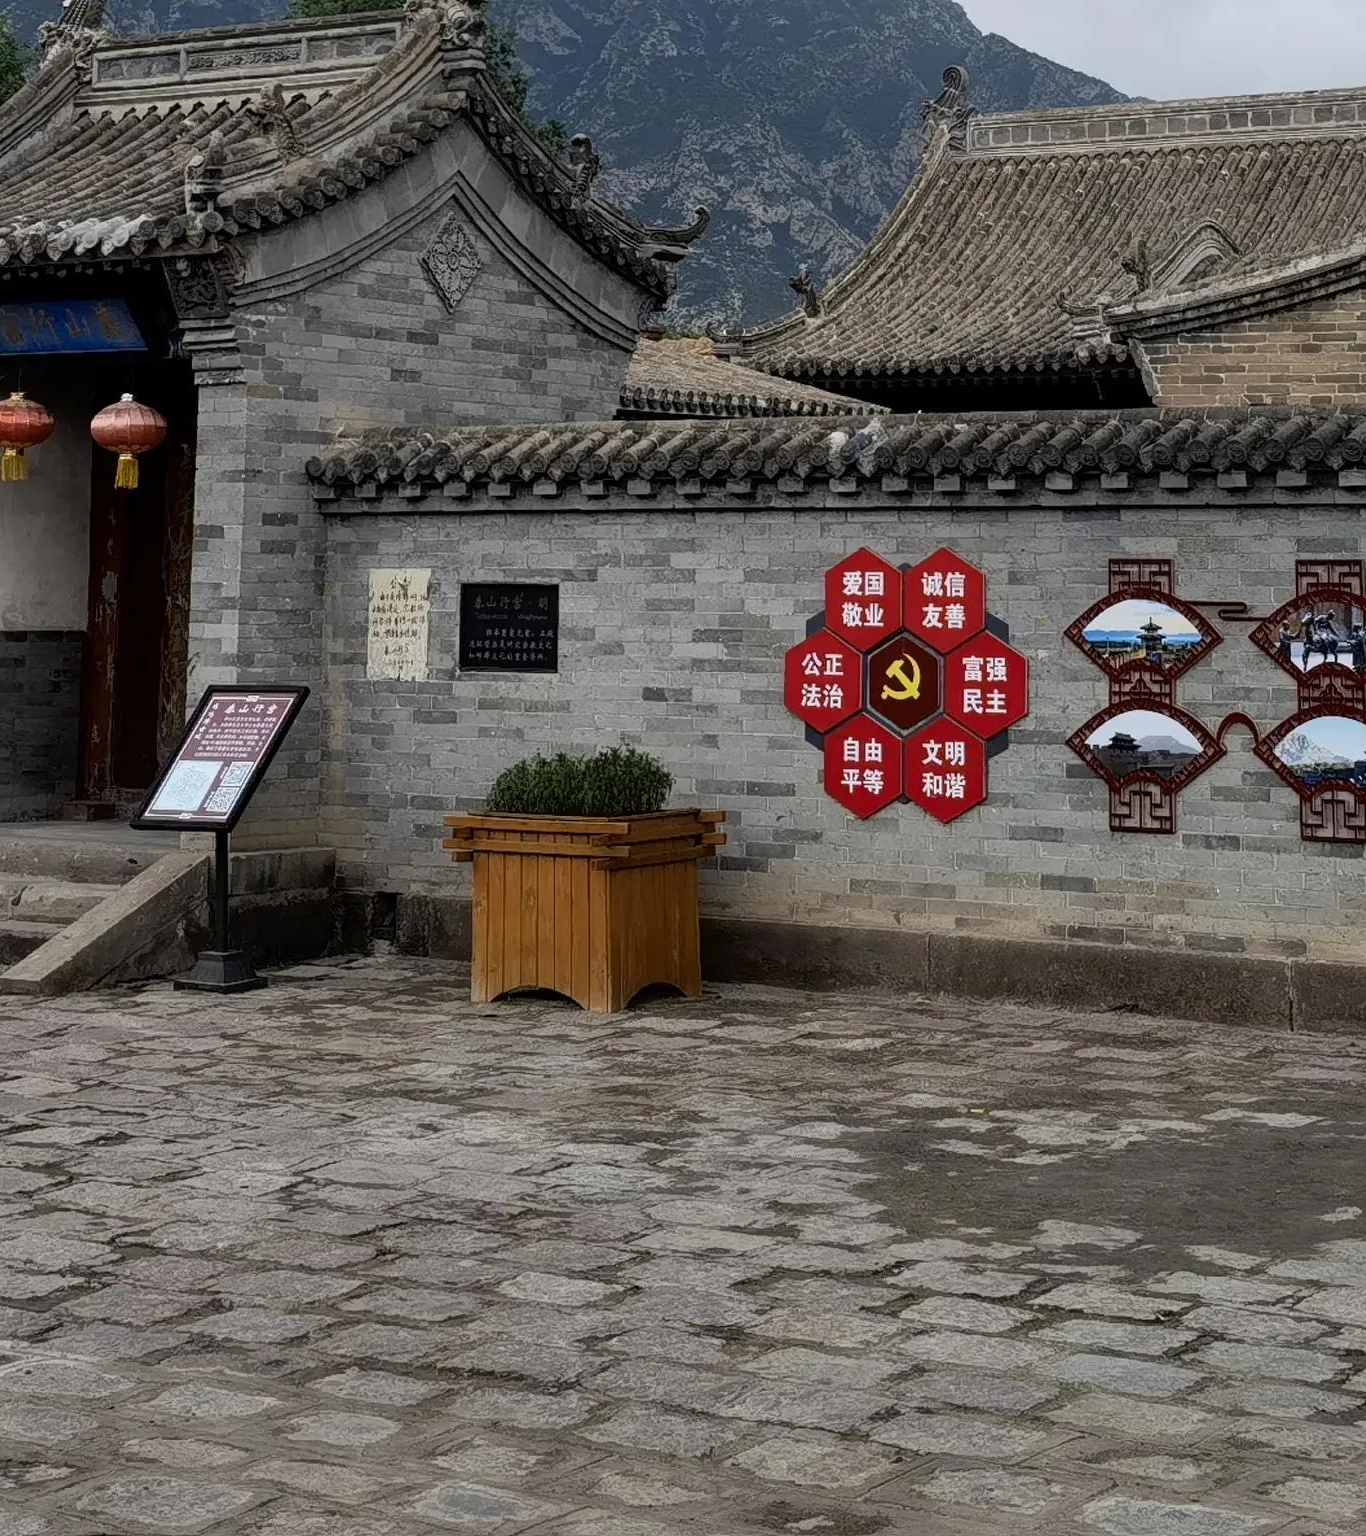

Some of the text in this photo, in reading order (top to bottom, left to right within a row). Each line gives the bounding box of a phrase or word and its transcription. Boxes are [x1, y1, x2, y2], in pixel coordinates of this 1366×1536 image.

[842, 571, 884, 596] 爱国
[922, 571, 966, 597] 诚信
[841, 602, 884, 627] 敬业
[922, 602, 966, 628] 友善
[801, 652, 844, 676] 公正
[963, 655, 1008, 682] 富强
[801, 683, 844, 709] 法治
[963, 689, 1007, 714] 民主
[843, 737, 883, 763] 自由
[922, 740, 965, 766] 文明
[841, 769, 884, 795] 平等
[922, 772, 966, 799] 和谐
